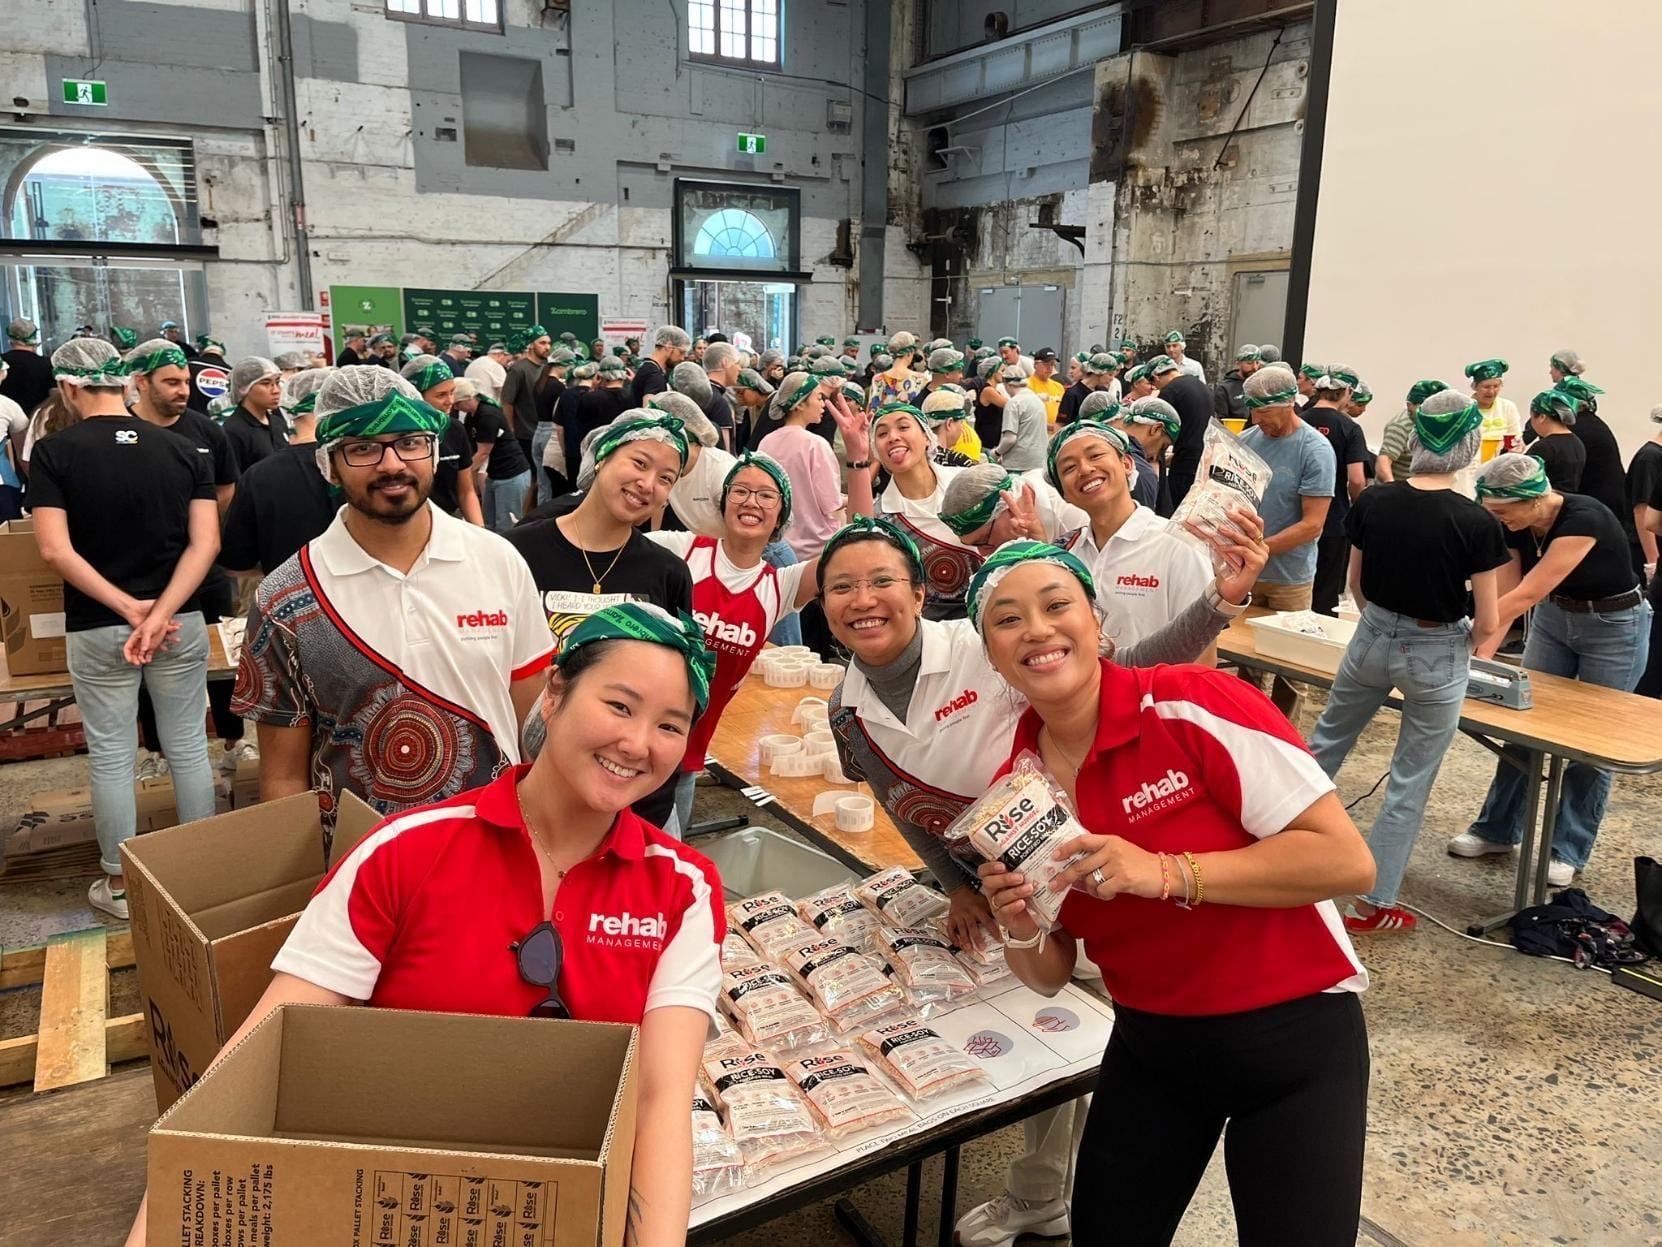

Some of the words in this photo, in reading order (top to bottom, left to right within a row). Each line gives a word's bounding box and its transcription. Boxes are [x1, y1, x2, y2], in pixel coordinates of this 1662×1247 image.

[115, 430, 138, 443] SC
[1116, 573, 1160, 588] rehab
[456, 609, 508, 628] rehab
[692, 608, 757, 647] ehab
[705, 638, 750, 657] GEMENT
[935, 689, 978, 722] rehab
[1122, 769, 1189, 814] rehab
[1128, 787, 1196, 824] MANAGEMENT
[587, 911, 668, 941] rehab
[799, 938, 839, 957] Rise
[730, 1068, 776, 1081] RICE-SOY
[212, 1170, 222, 1199] pallet
[226, 1176, 234, 1196] row
[250, 1163, 261, 1192] pallet
[263, 1164, 273, 1180] lbs
[183, 1169, 193, 1223] STACKING
[237, 1179, 249, 1207] pallet
[262, 1182, 273, 1210] 2,175
[355, 1168, 364, 1208] STACKING
[213, 1201, 222, 1219] per
[226, 1198, 235, 1216] per
[252, 1194, 261, 1212] per
[238, 1209, 247, 1227] per
[249, 1214, 258, 1243] meals
[353, 1209, 361, 1237] PALLET
[222, 1218, 232, 1247] boxes
